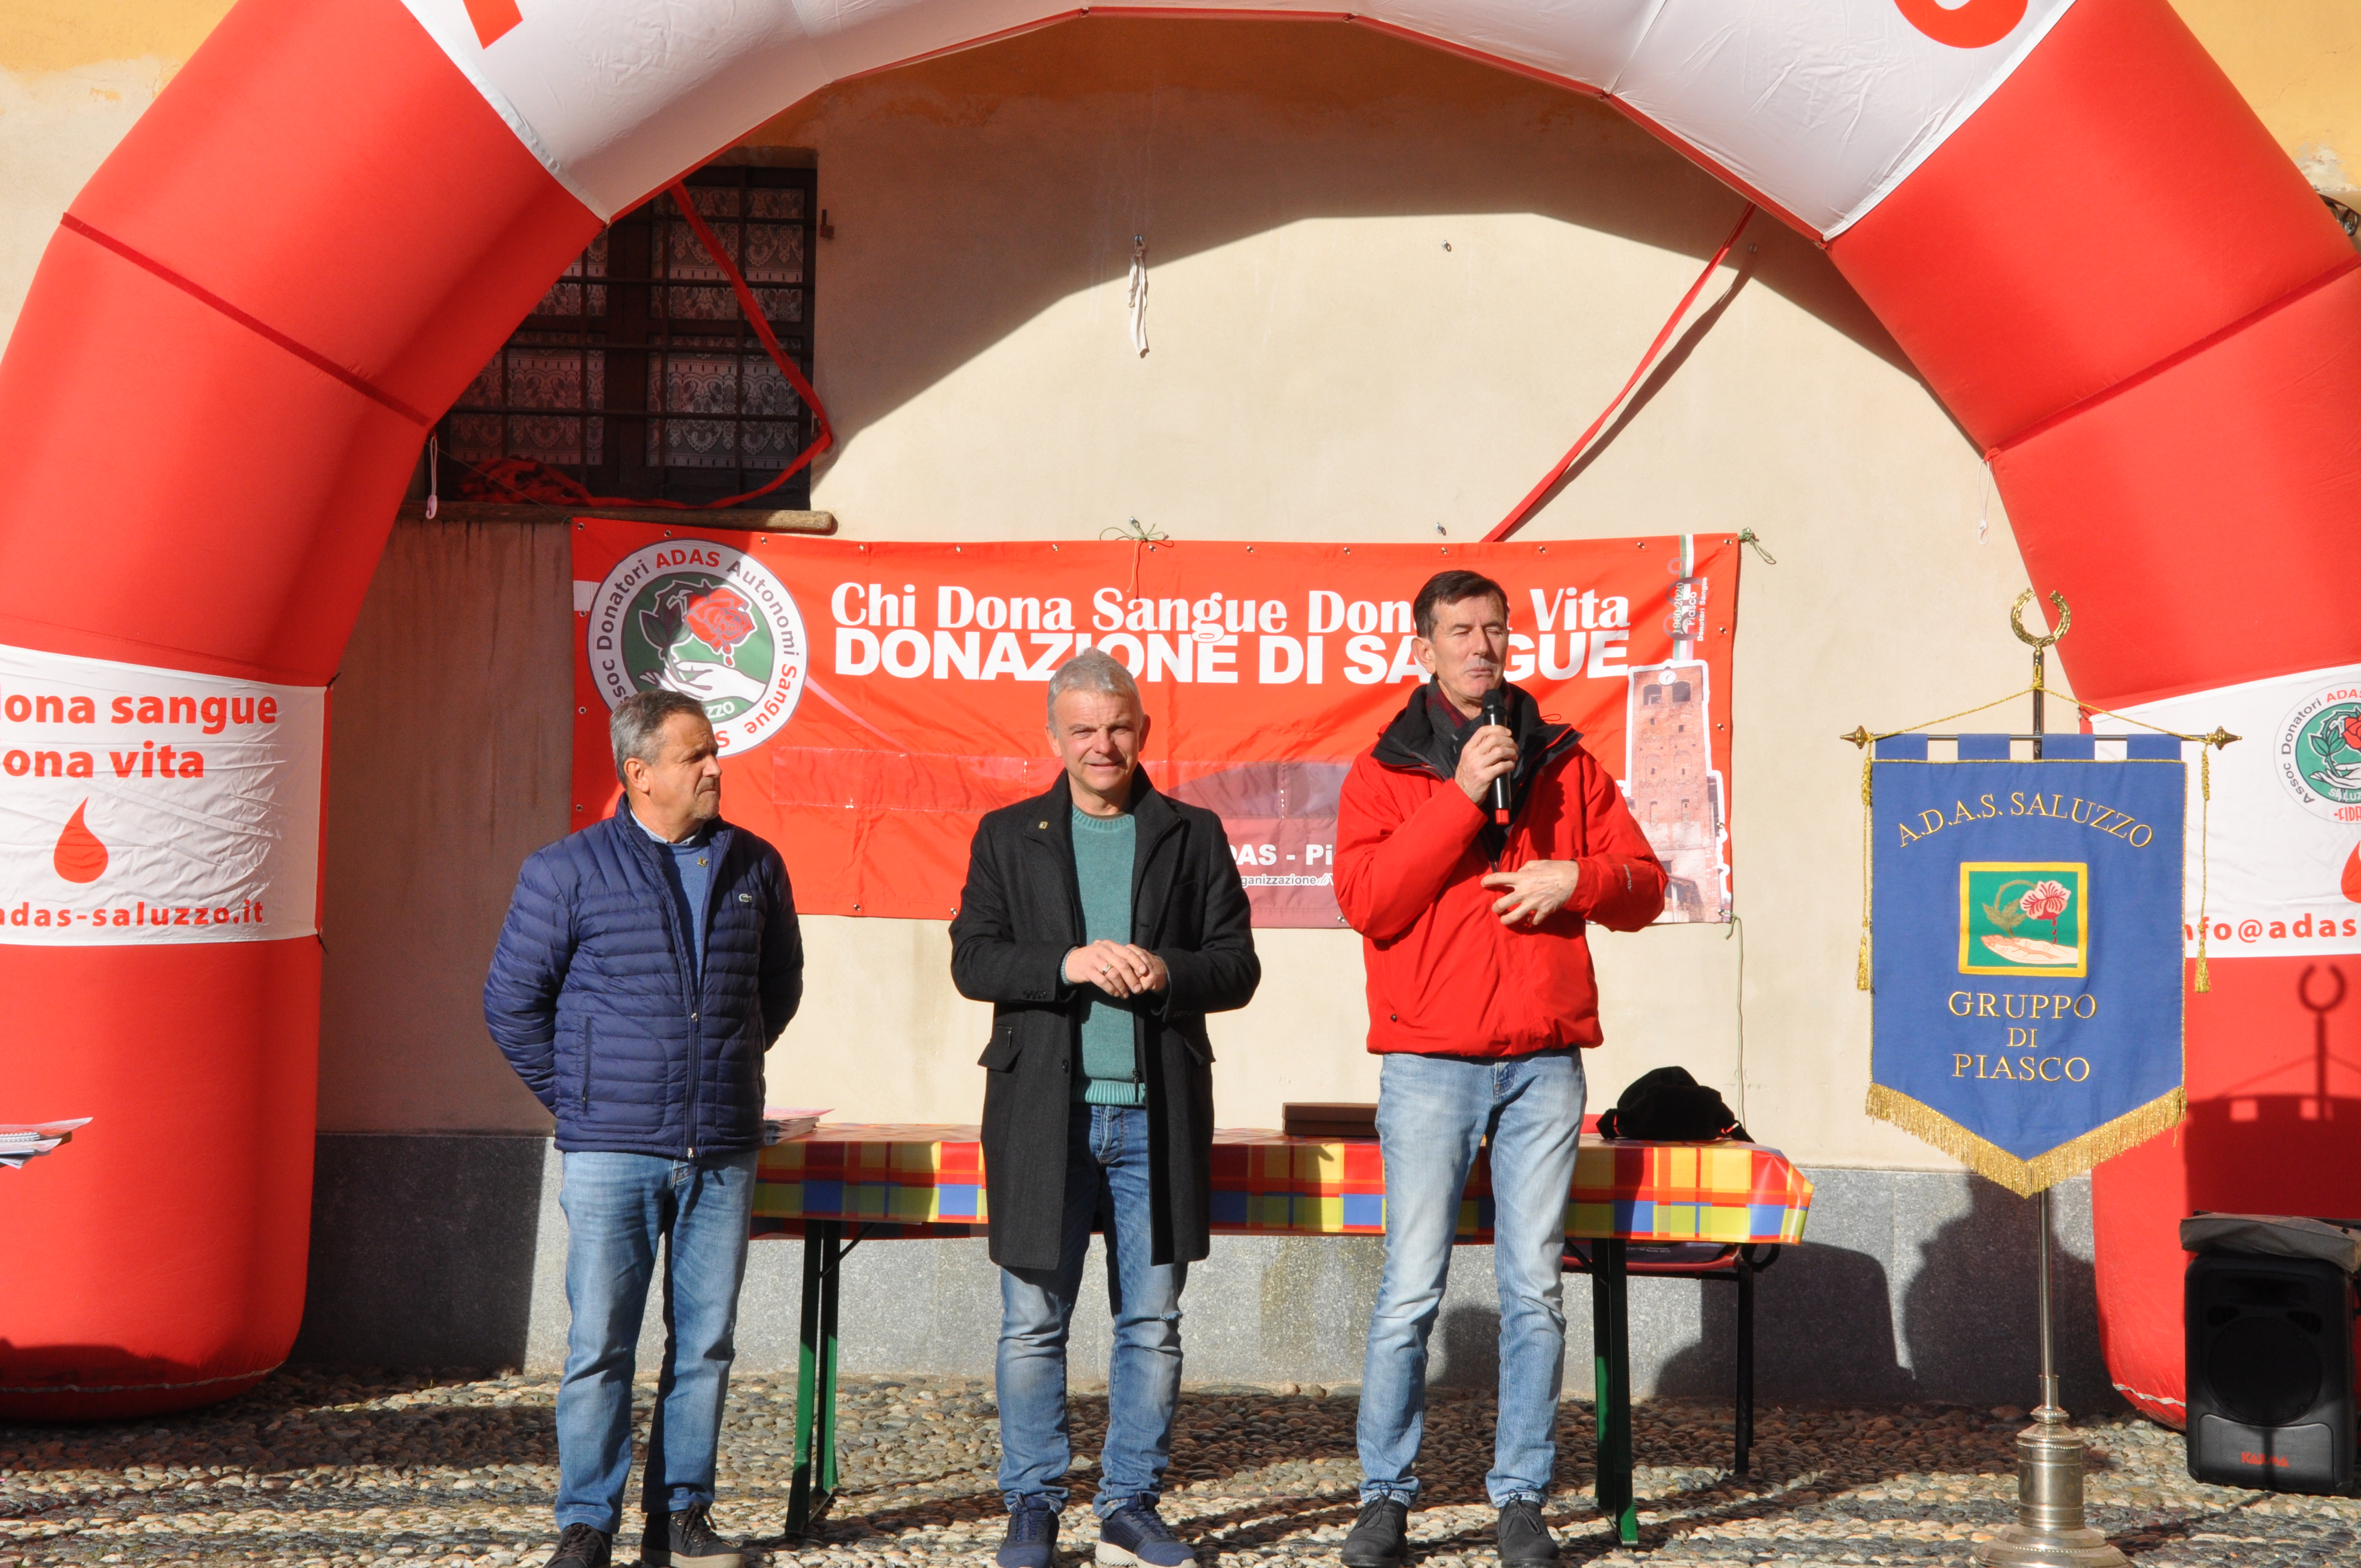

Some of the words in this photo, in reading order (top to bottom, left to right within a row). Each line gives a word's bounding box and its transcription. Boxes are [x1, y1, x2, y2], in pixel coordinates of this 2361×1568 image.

[656, 549, 721, 569] ADAS
[597, 559, 650, 650] Donatori
[726, 560, 799, 656] Autonomi
[1672, 582, 1684, 634] 1960-2020
[1686, 591, 1697, 626] Piasco
[1699, 576, 1709, 606] Sangue
[831, 582, 916, 627] Chi
[937, 586, 1075, 630] Dona
[1092, 587, 1287, 644] Sangue
[1308, 590, 1417, 633] Don
[1530, 586, 1631, 631] Vita
[1697, 608, 1706, 642] Donatori
[1258, 635, 1323, 684] DI
[1343, 630, 1629, 685] SAGUE
[602, 659, 630, 703] soc
[744, 664, 797, 734] Sangue
[2326, 689, 2361, 703] ADA
[0, 688, 96, 724] ona
[110, 695, 278, 734] sangue
[2281, 698, 2322, 755] Donatori
[0, 746, 94, 778] ona
[109, 740, 204, 778] vita
[2283, 763, 2316, 804] Assoc
[1897, 794, 2003, 848] A.D.A.S.
[2010, 792, 2154, 848] SALUZZO
[1241, 874, 1316, 887] ganizzazione
[0, 899, 264, 927] das-saluzzo.it
[1947, 990, 2097, 1019] GRUPPO
[2006, 1027, 2038, 1048] DI
[1952, 1054, 2090, 1082] PIASCO
